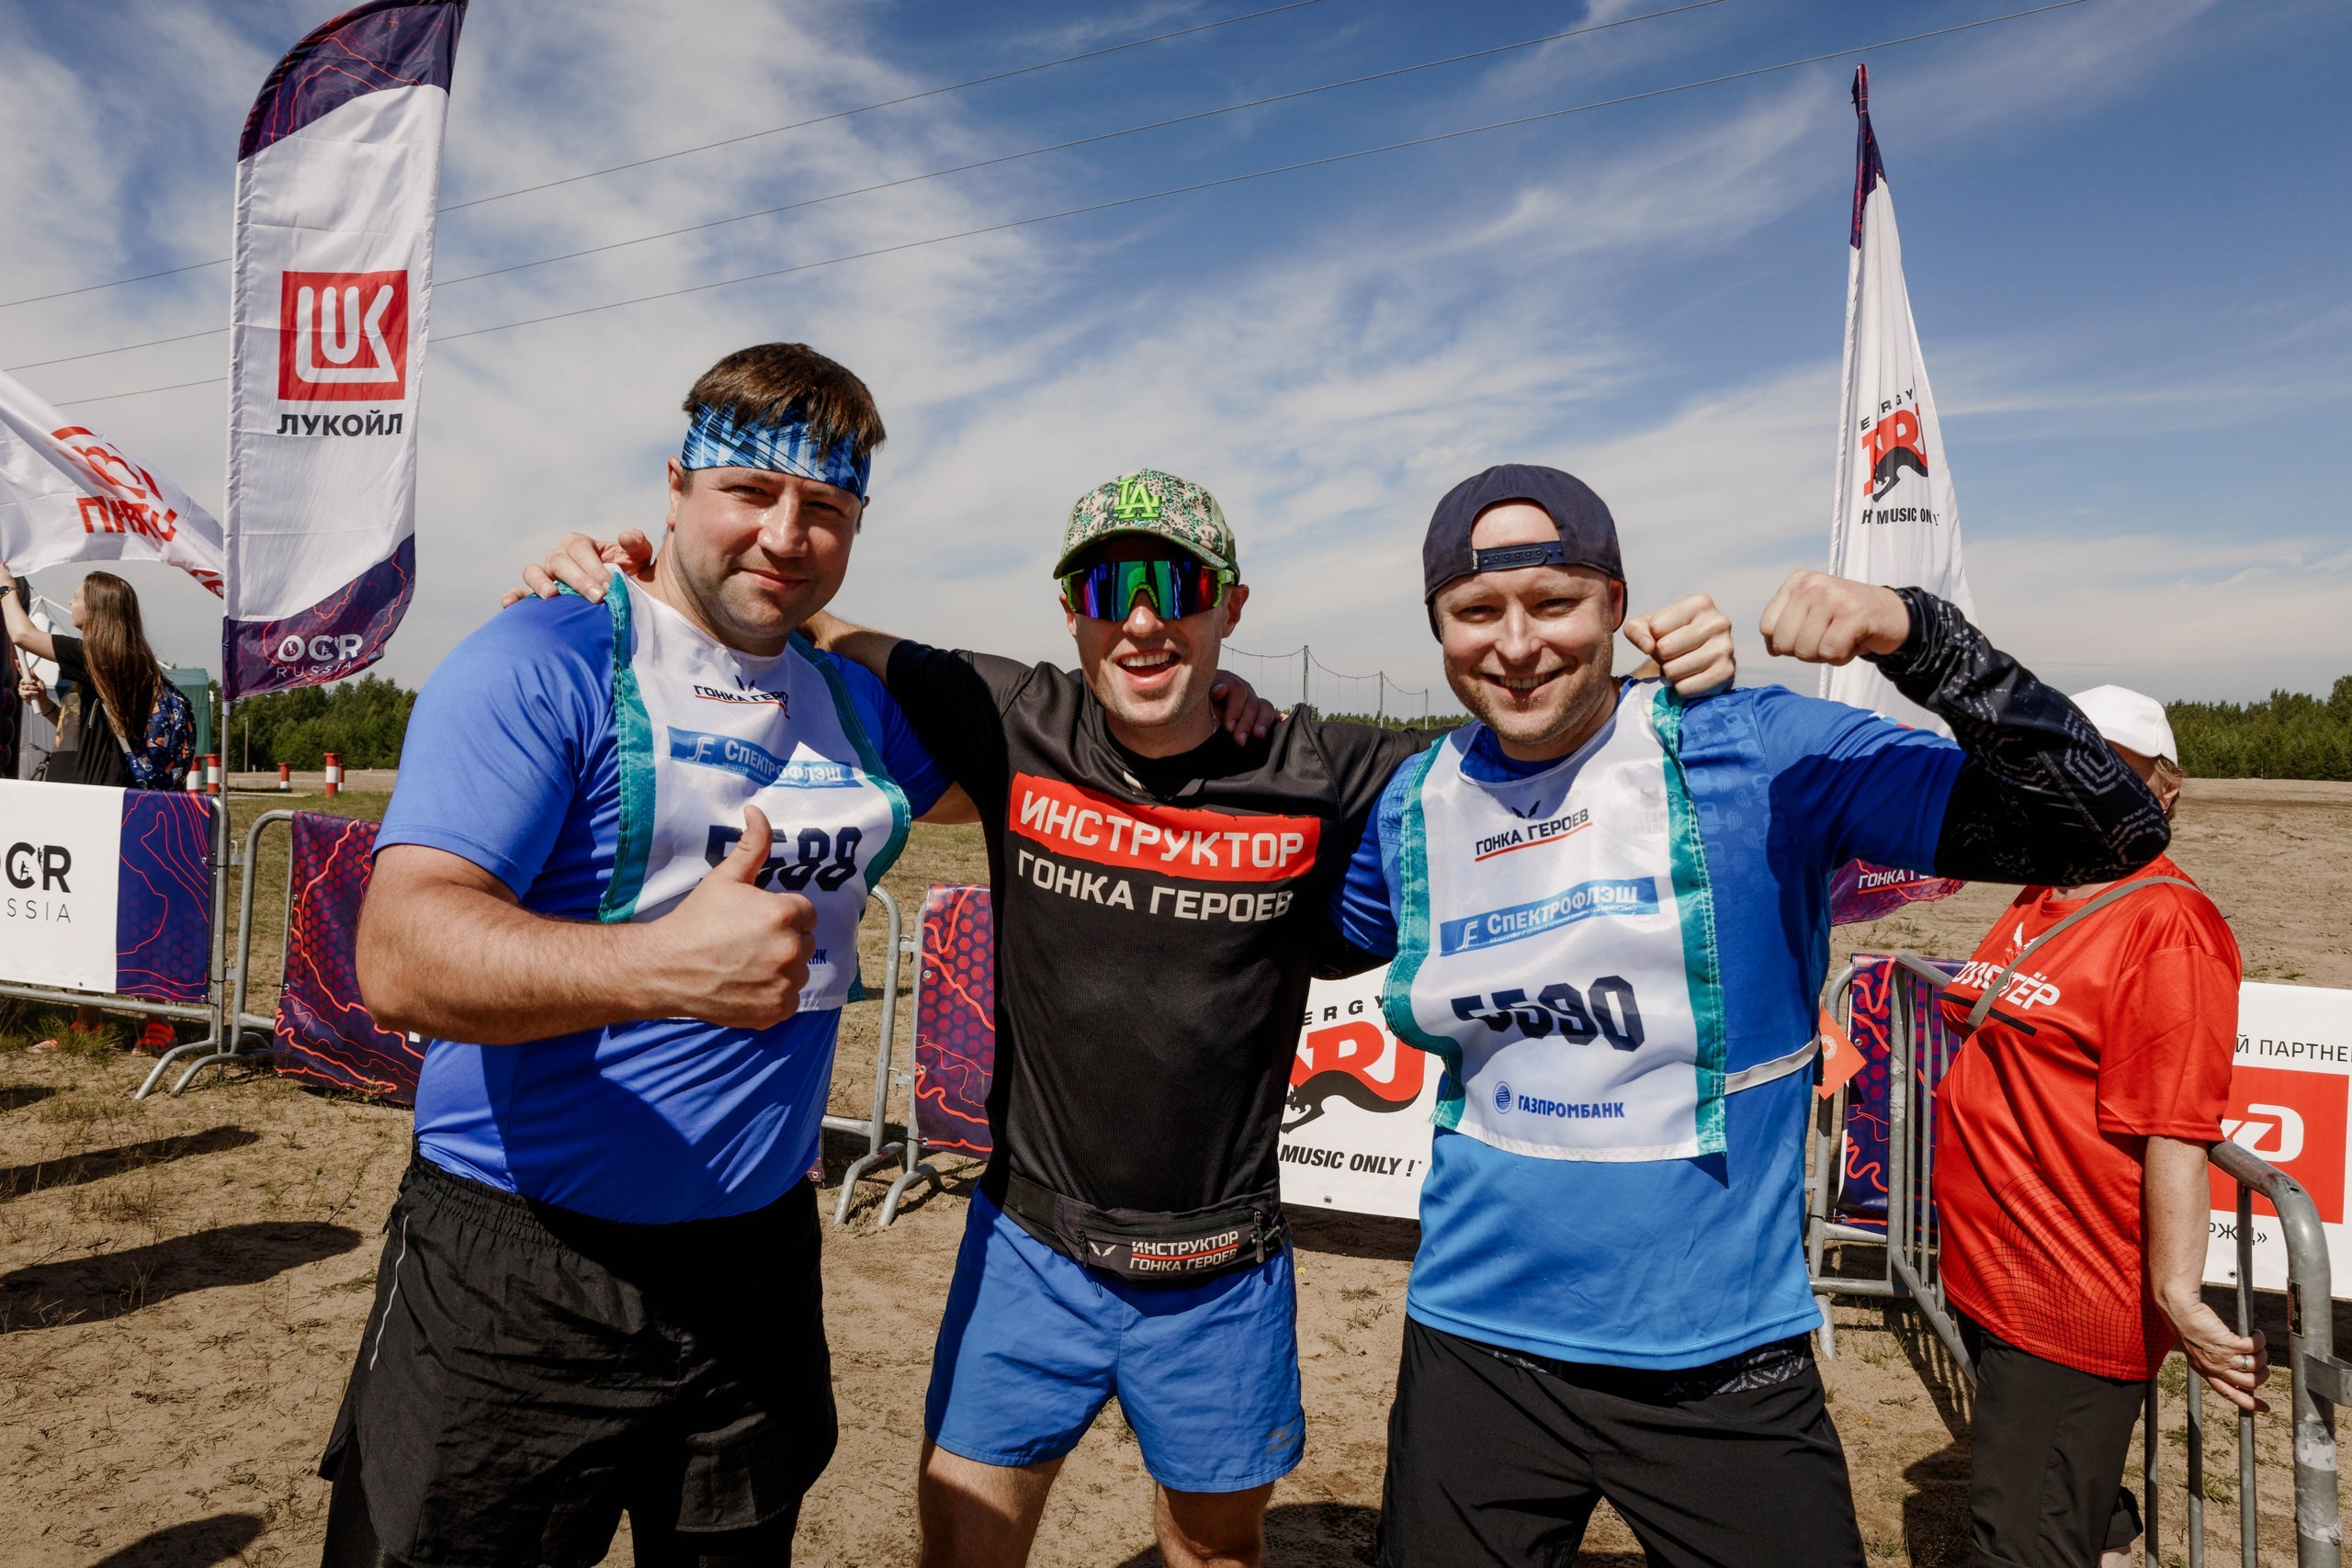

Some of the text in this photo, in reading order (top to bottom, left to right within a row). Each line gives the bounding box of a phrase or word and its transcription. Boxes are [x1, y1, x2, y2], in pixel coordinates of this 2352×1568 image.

[277, 410, 403, 437] ЛУКОЙЛ
[1114, 477, 1161, 519] LA
[1877, 507, 1917, 525] MUSIC
[277, 634, 363, 661] OCR
[277, 660, 352, 678] RUSSIA
[694, 685, 750, 702] ГОНКА
[1020, 790, 1304, 868] ИНСТРУКТОР
[1476, 808, 1589, 855] ГОНКА ГЕРОЕВ
[0, 841, 72, 893] CR
[1858, 869, 1905, 889] ГОНКА
[1018, 849, 1293, 922] ГОНКА ГЕРОЕВ
[2260, 1039, 2352, 1063] ПАРТНЕ
[1518, 1094, 1625, 1119] ГАЗПРОМБАНК
[1279, 1145, 1345, 1168] MUSIC
[1350, 1154, 1403, 1176] ONLY
[1131, 1231, 1238, 1256] ИНСТРУКТОР
[1129, 1248, 1238, 1271] ГОНКА ГЕРОЕВ
